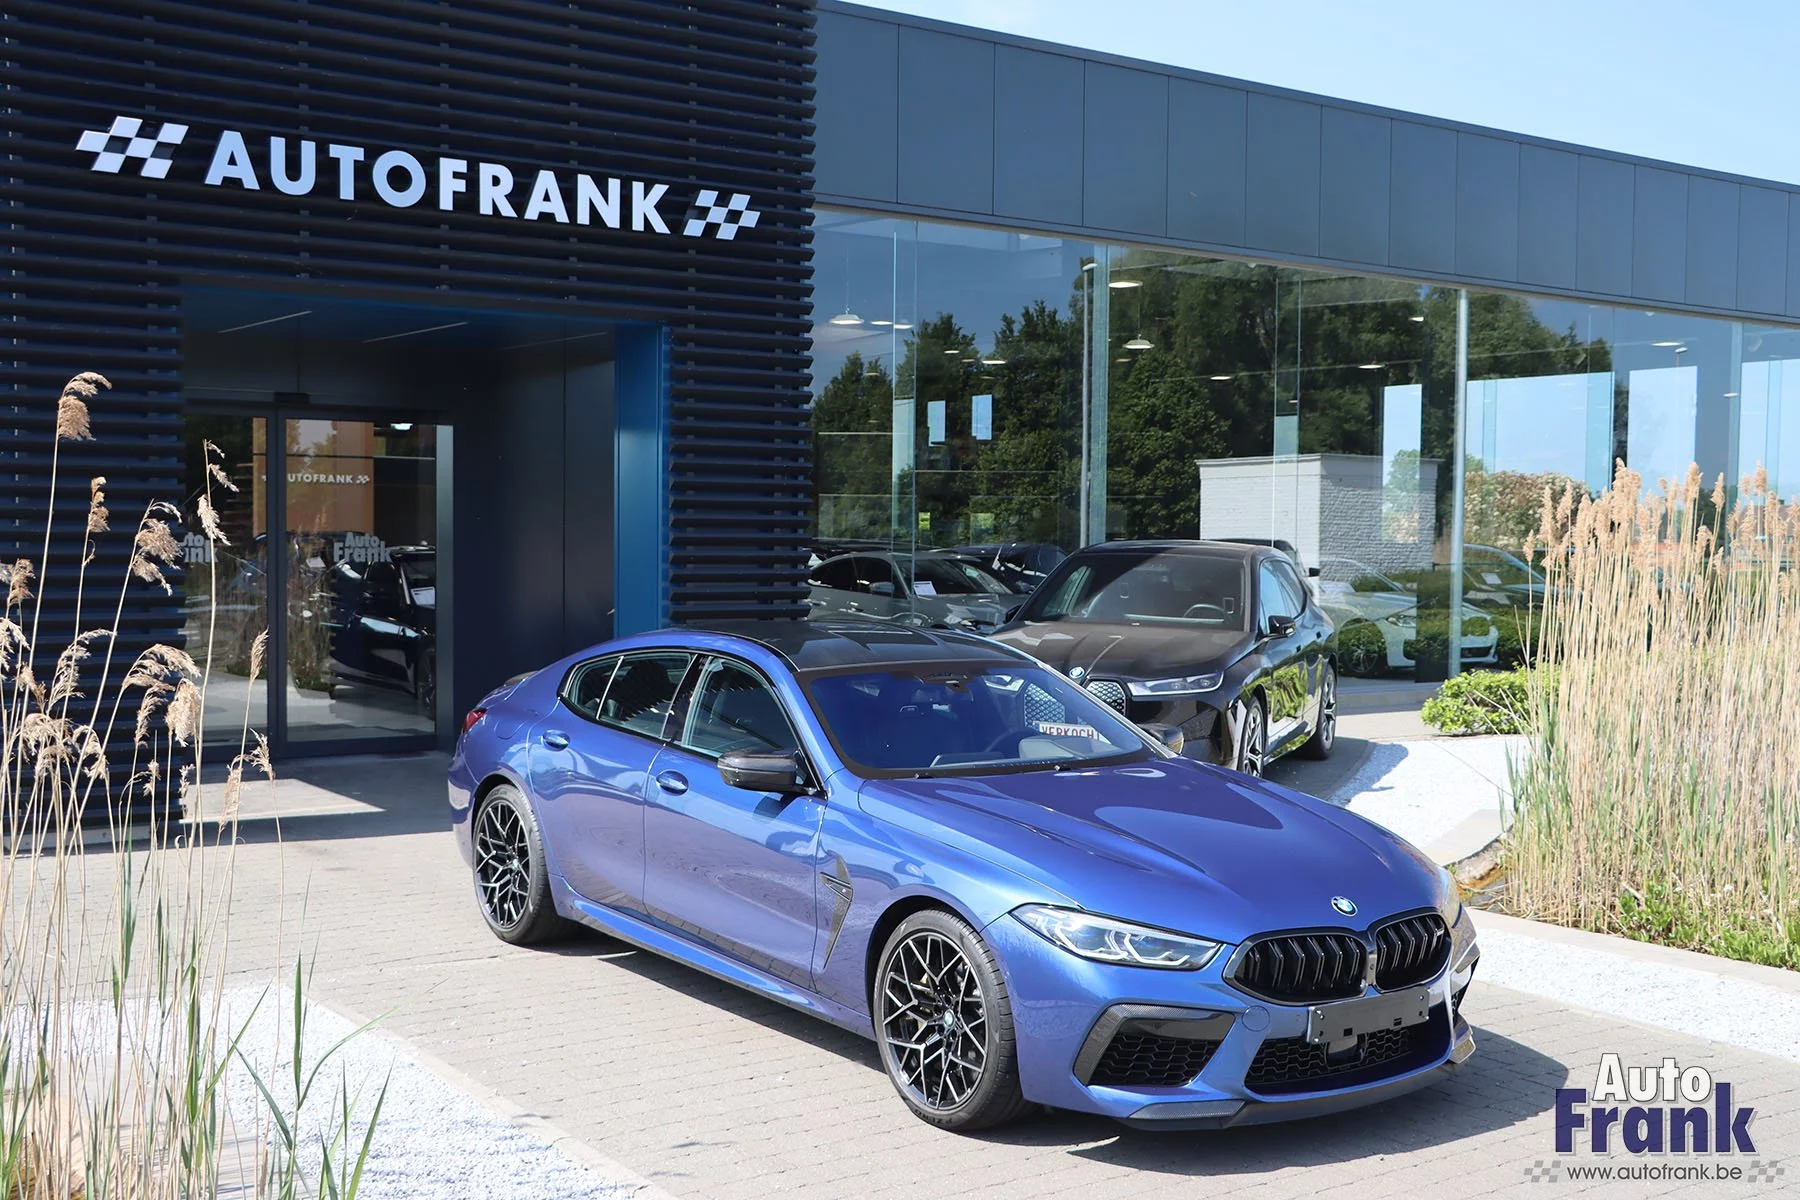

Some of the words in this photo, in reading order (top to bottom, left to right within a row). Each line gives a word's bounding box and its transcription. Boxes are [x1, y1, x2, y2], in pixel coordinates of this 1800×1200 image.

[205, 130, 671, 235] AUTOFRANK
[287, 473, 353, 484] UTOFRANK
[345, 532, 380, 548] Auto
[333, 541, 393, 563] Frank
